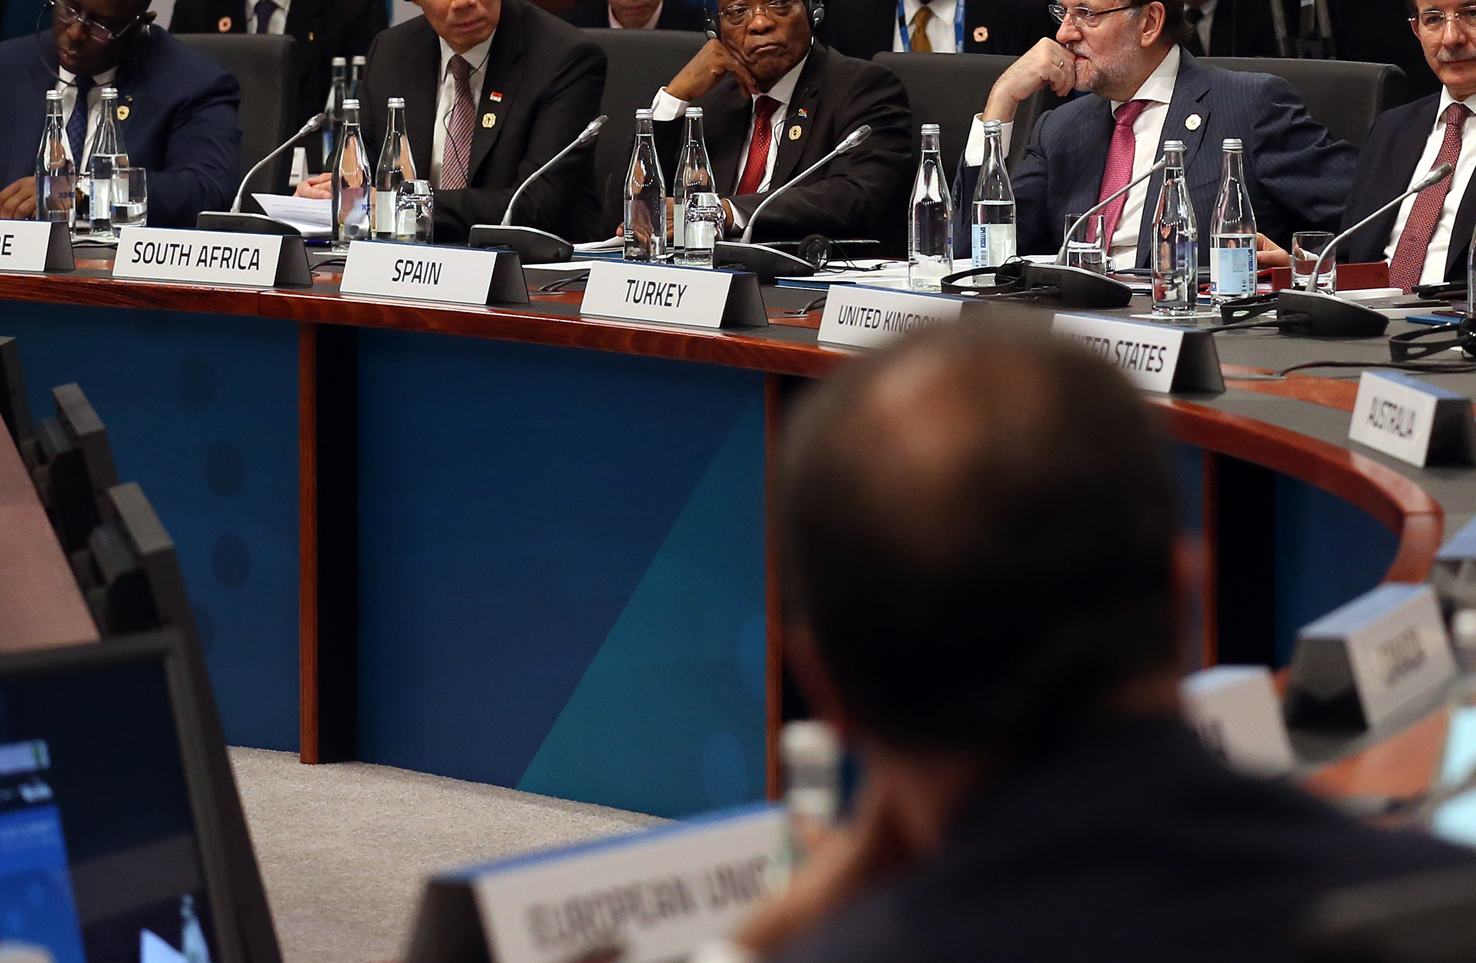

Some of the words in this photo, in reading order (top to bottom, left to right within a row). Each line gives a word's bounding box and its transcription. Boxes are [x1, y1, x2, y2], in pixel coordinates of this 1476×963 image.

[131, 240, 190, 267] SOUTH
[196, 245, 261, 271] AFRICA
[391, 259, 443, 285] SPAIN
[625, 279, 688, 308] TURKEY
[838, 304, 882, 329] UNITED
[1112, 339, 1167, 373] STATES
